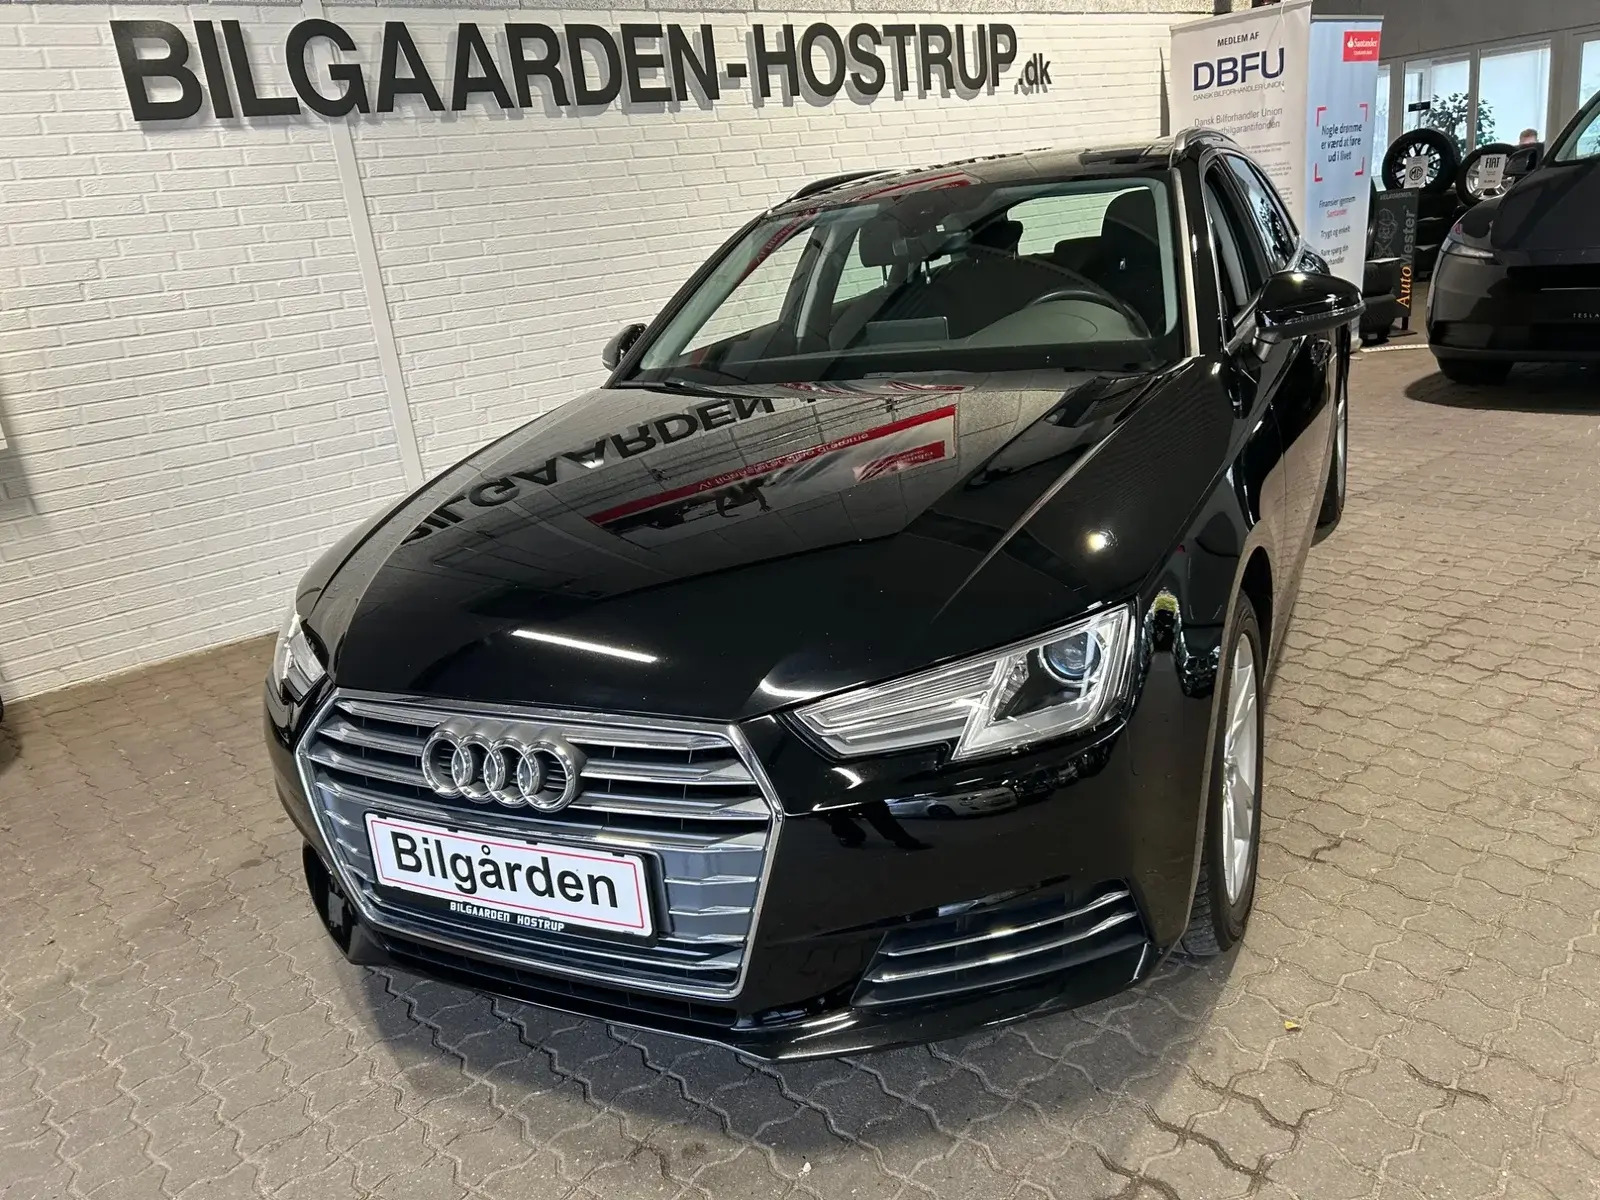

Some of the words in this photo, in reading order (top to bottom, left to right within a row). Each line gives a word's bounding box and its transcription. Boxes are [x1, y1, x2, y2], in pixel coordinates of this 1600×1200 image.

[1217, 33, 1249, 47] MEDLEM
[1250, 31, 1260, 41] AF
[1193, 47, 1285, 91] DBFU
[1193, 92, 1213, 101] DANSK
[1214, 83, 1263, 97] BILFORHANDLER
[1264, 80, 1285, 89] UNION
[1194, 115, 1215, 127] Dansk
[1217, 109, 1260, 124] Bilforhandler
[1261, 107, 1283, 118] Union
[1321, 124, 1339, 138] Nogle
[1339, 122, 1362, 134] drømme
[1320, 141, 1327, 150] er
[1327, 138, 1344, 149] værd
[1327, 153, 1337, 162] ud
[1340, 151, 1352, 161] livet
[1485, 156, 1501, 168] FIAT
[390, 830, 618, 909] Bilgården
[450, 901, 510, 923] BILGAARDEN
[517, 915, 565, 932] HOSTRUP
